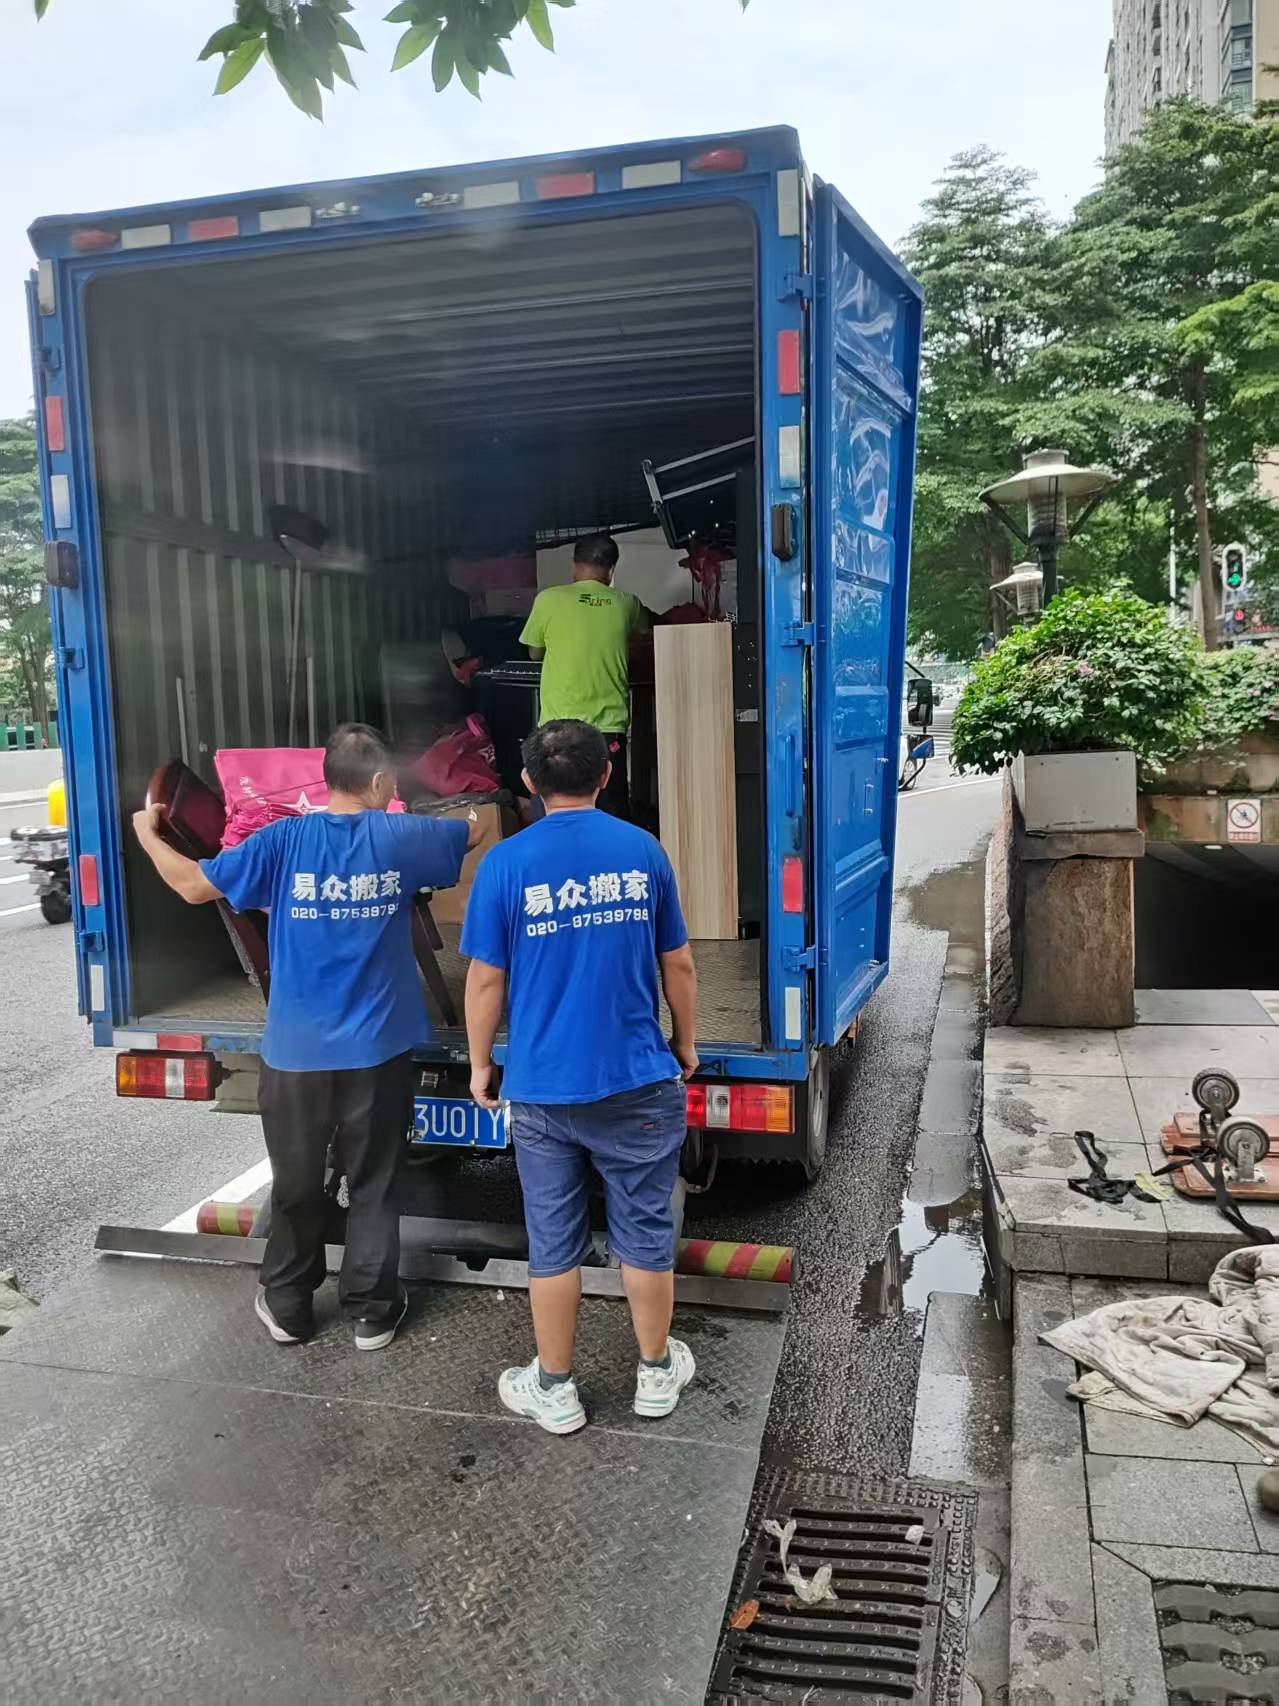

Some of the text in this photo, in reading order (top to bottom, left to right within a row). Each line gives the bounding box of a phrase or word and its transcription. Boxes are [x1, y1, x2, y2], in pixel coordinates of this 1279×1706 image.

[292, 870, 402, 902] 易众搬家
[524, 869, 649, 917] 易众搬家
